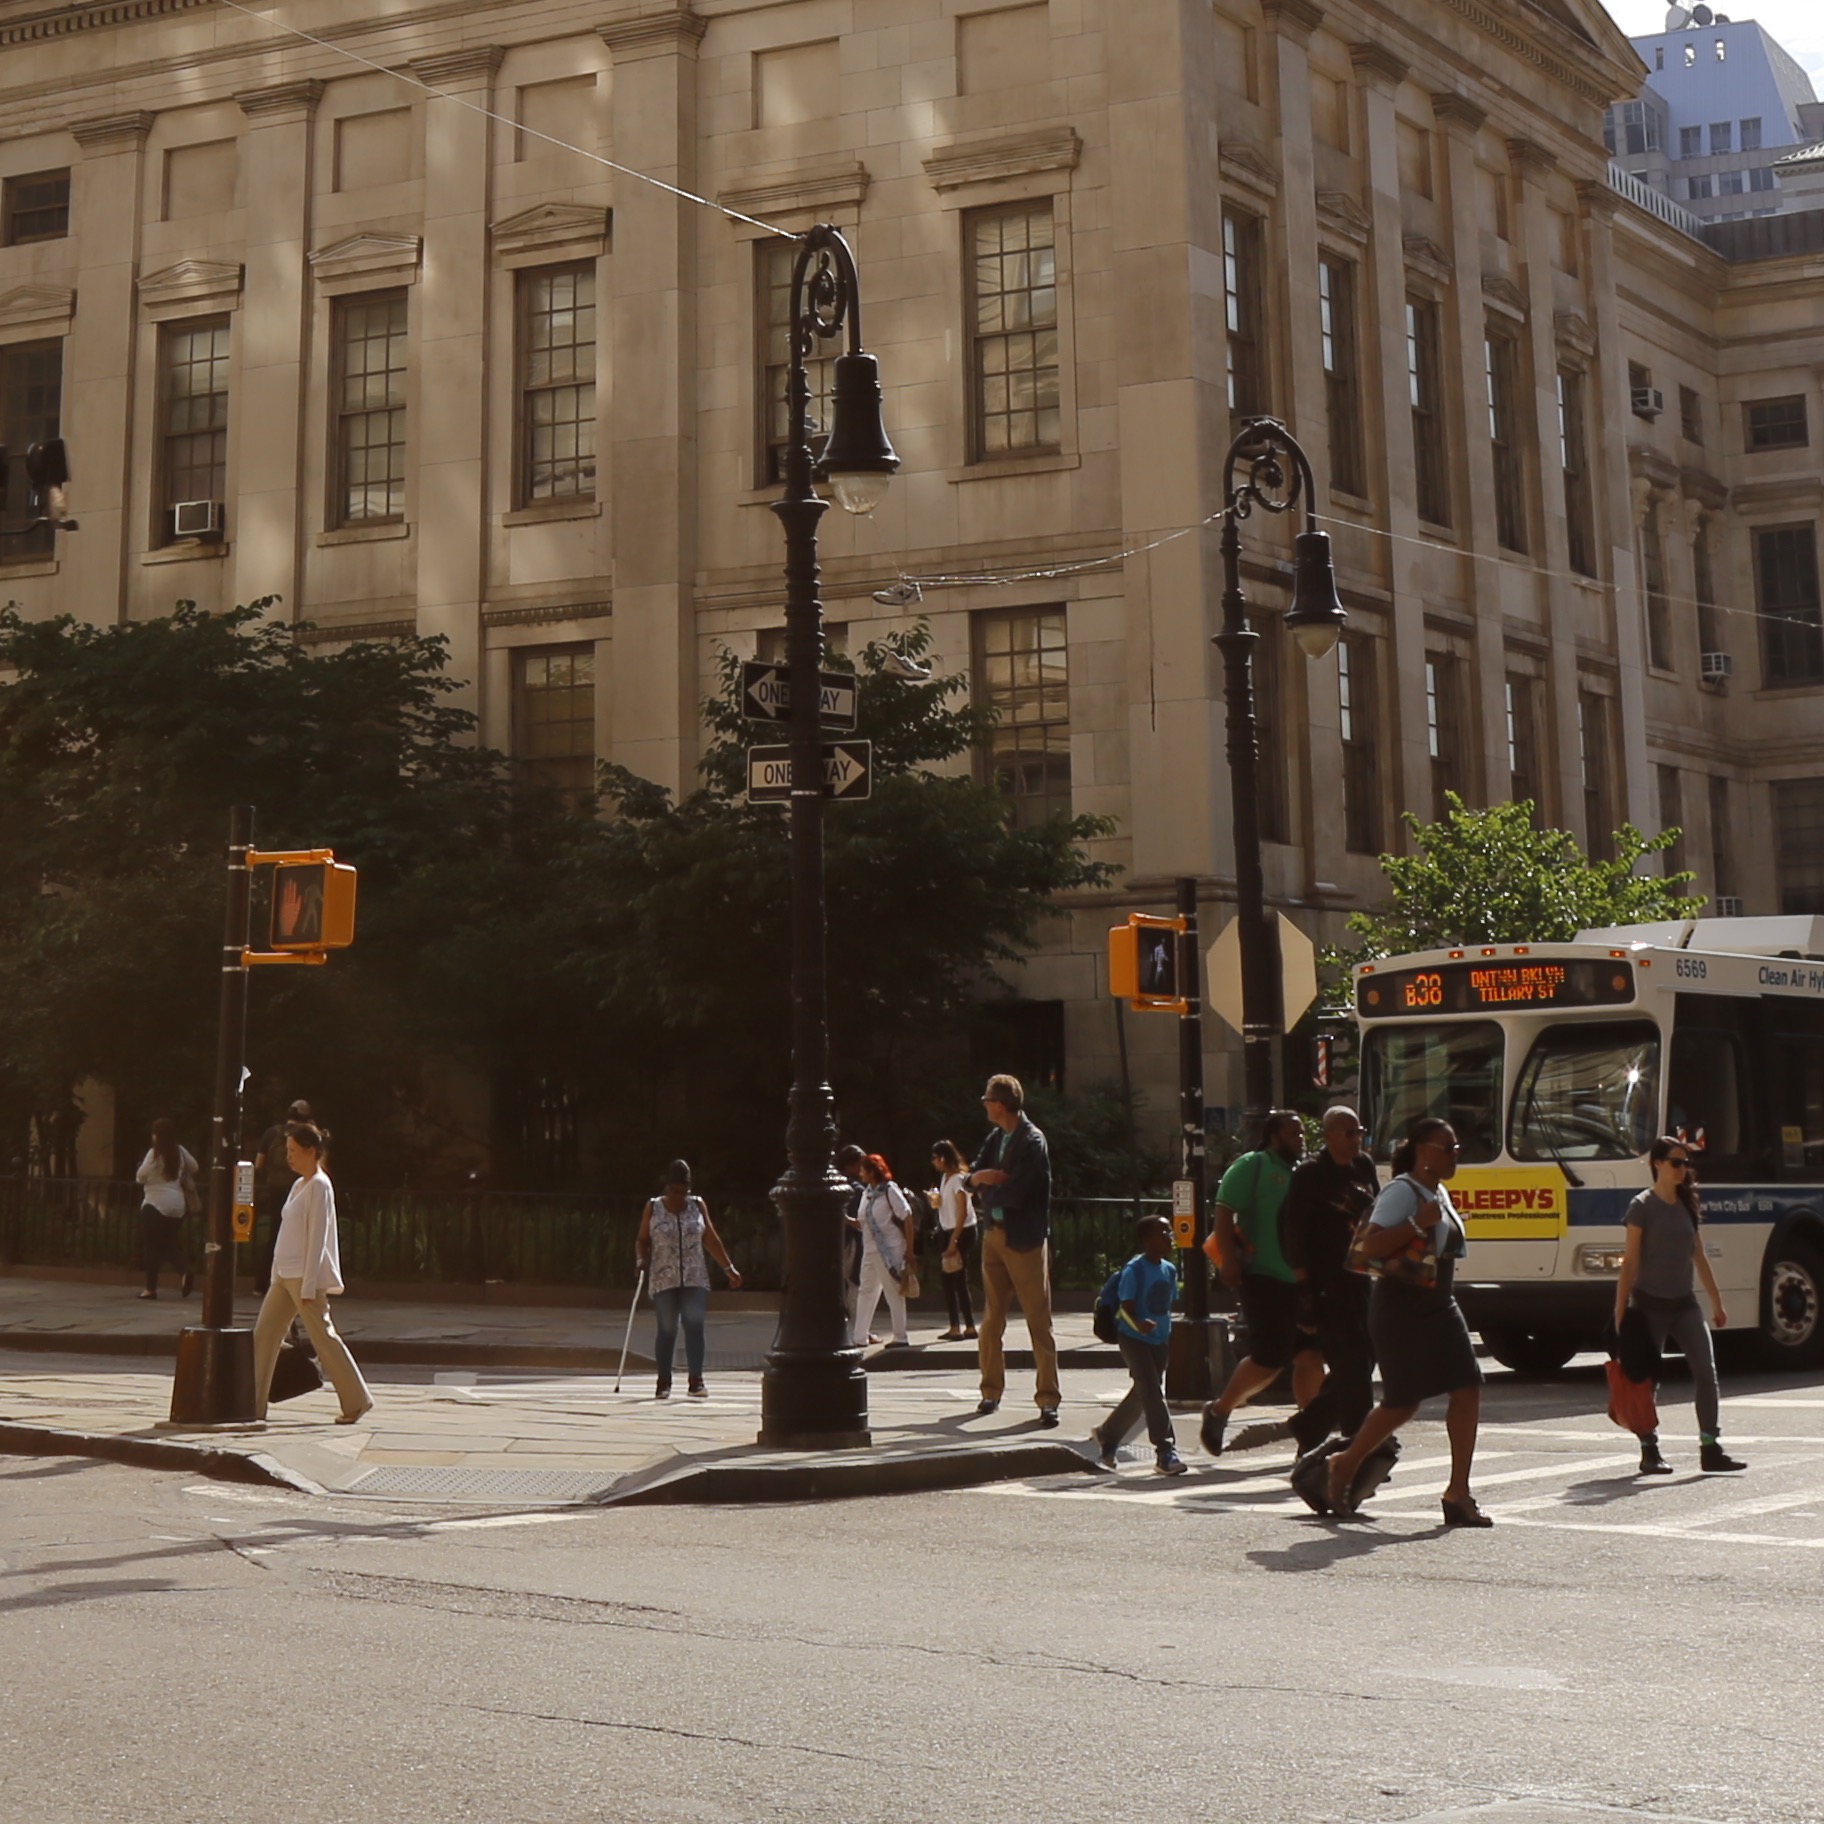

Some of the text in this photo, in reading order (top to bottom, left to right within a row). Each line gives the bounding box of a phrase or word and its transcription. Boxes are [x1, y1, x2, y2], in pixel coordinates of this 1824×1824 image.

[820, 689, 840, 711] AY
[1676, 958, 1707, 979] 6569
[1758, 966, 1788, 987] Clean
[1790, 969, 1806, 987] Air
[1406, 974, 1442, 1007] B38
[1479, 983, 1556, 1002] TILLARY ST
[1471, 1212, 1505, 1220] Mattress
[1507, 1212, 1560, 1220] Professionals
[1737, 1200, 1750, 1211] Bus
